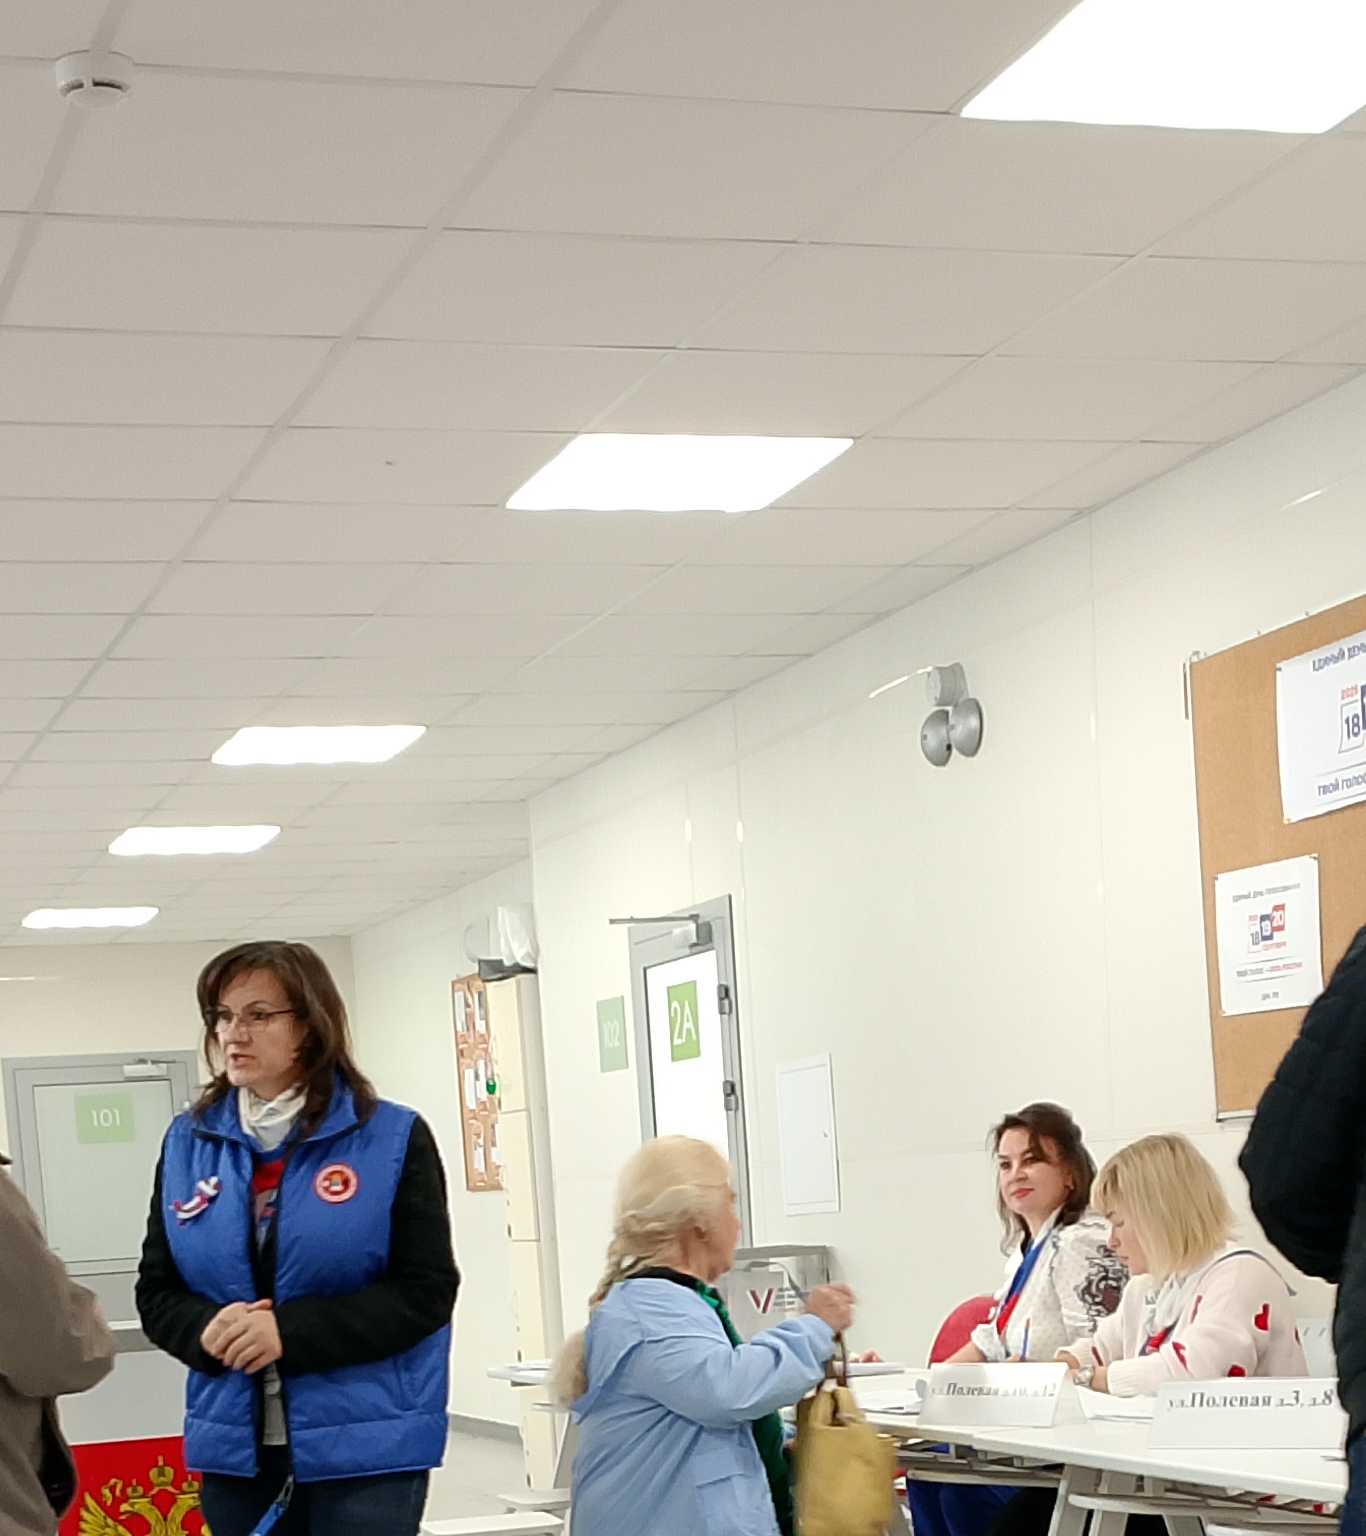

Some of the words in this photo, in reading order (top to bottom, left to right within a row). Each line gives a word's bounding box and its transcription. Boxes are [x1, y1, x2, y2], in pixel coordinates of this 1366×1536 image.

[1344, 713, 1361, 740] 18
[1318, 778, 1340, 796] ТВОЙ
[1272, 909, 1285, 927] 20
[91, 1108, 121, 1127] 101
